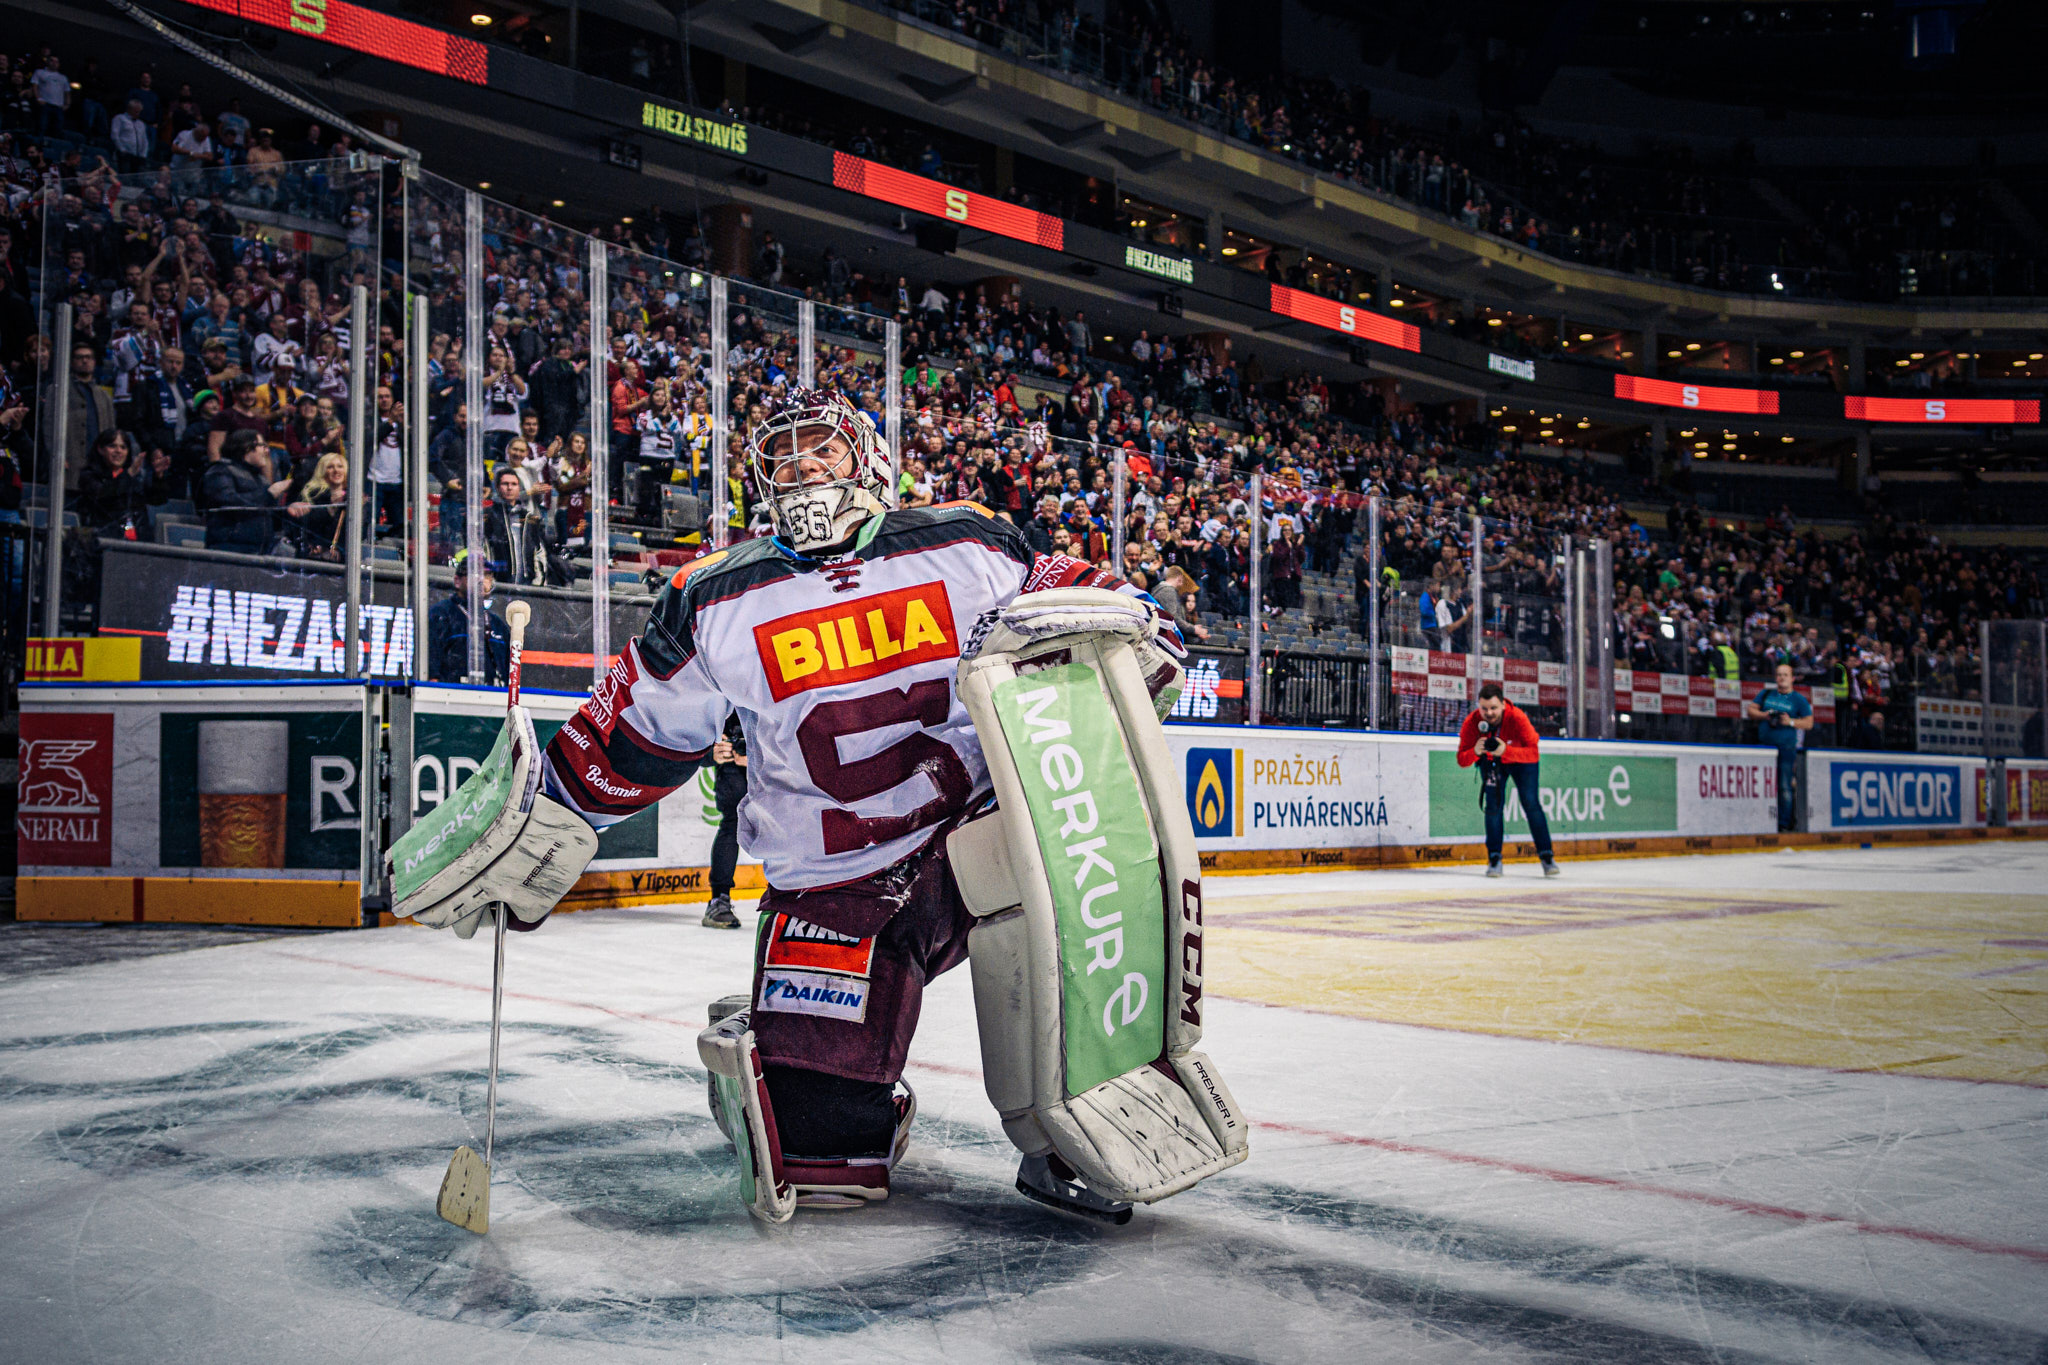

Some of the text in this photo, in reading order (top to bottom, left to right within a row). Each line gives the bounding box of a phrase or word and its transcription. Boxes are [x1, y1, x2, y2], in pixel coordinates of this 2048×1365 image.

[945, 189, 968, 221] S
[1340, 306, 1356, 332] S
[1682, 385, 1700, 408] S
[1925, 400, 1946, 421] S
[772, 599, 948, 683] BILLA
[1171, 658, 1220, 717] VÍŠ
[585, 764, 642, 798] Bohemia
[1254, 754, 1342, 786] PRAŽSKÁ
[1699, 764, 1760, 799] GALERIE
[1840, 770, 1954, 818] SENCOR
[1253, 795, 1389, 828] PLYNÁRENSKÁ
[522, 847, 557, 887] PREMIER
[1310, 851, 1344, 867] Tipsport
[645, 870, 701, 894] Tipsport
[781, 985, 862, 1008] DAIKIN
[1192, 1060, 1231, 1120] PREMIER
